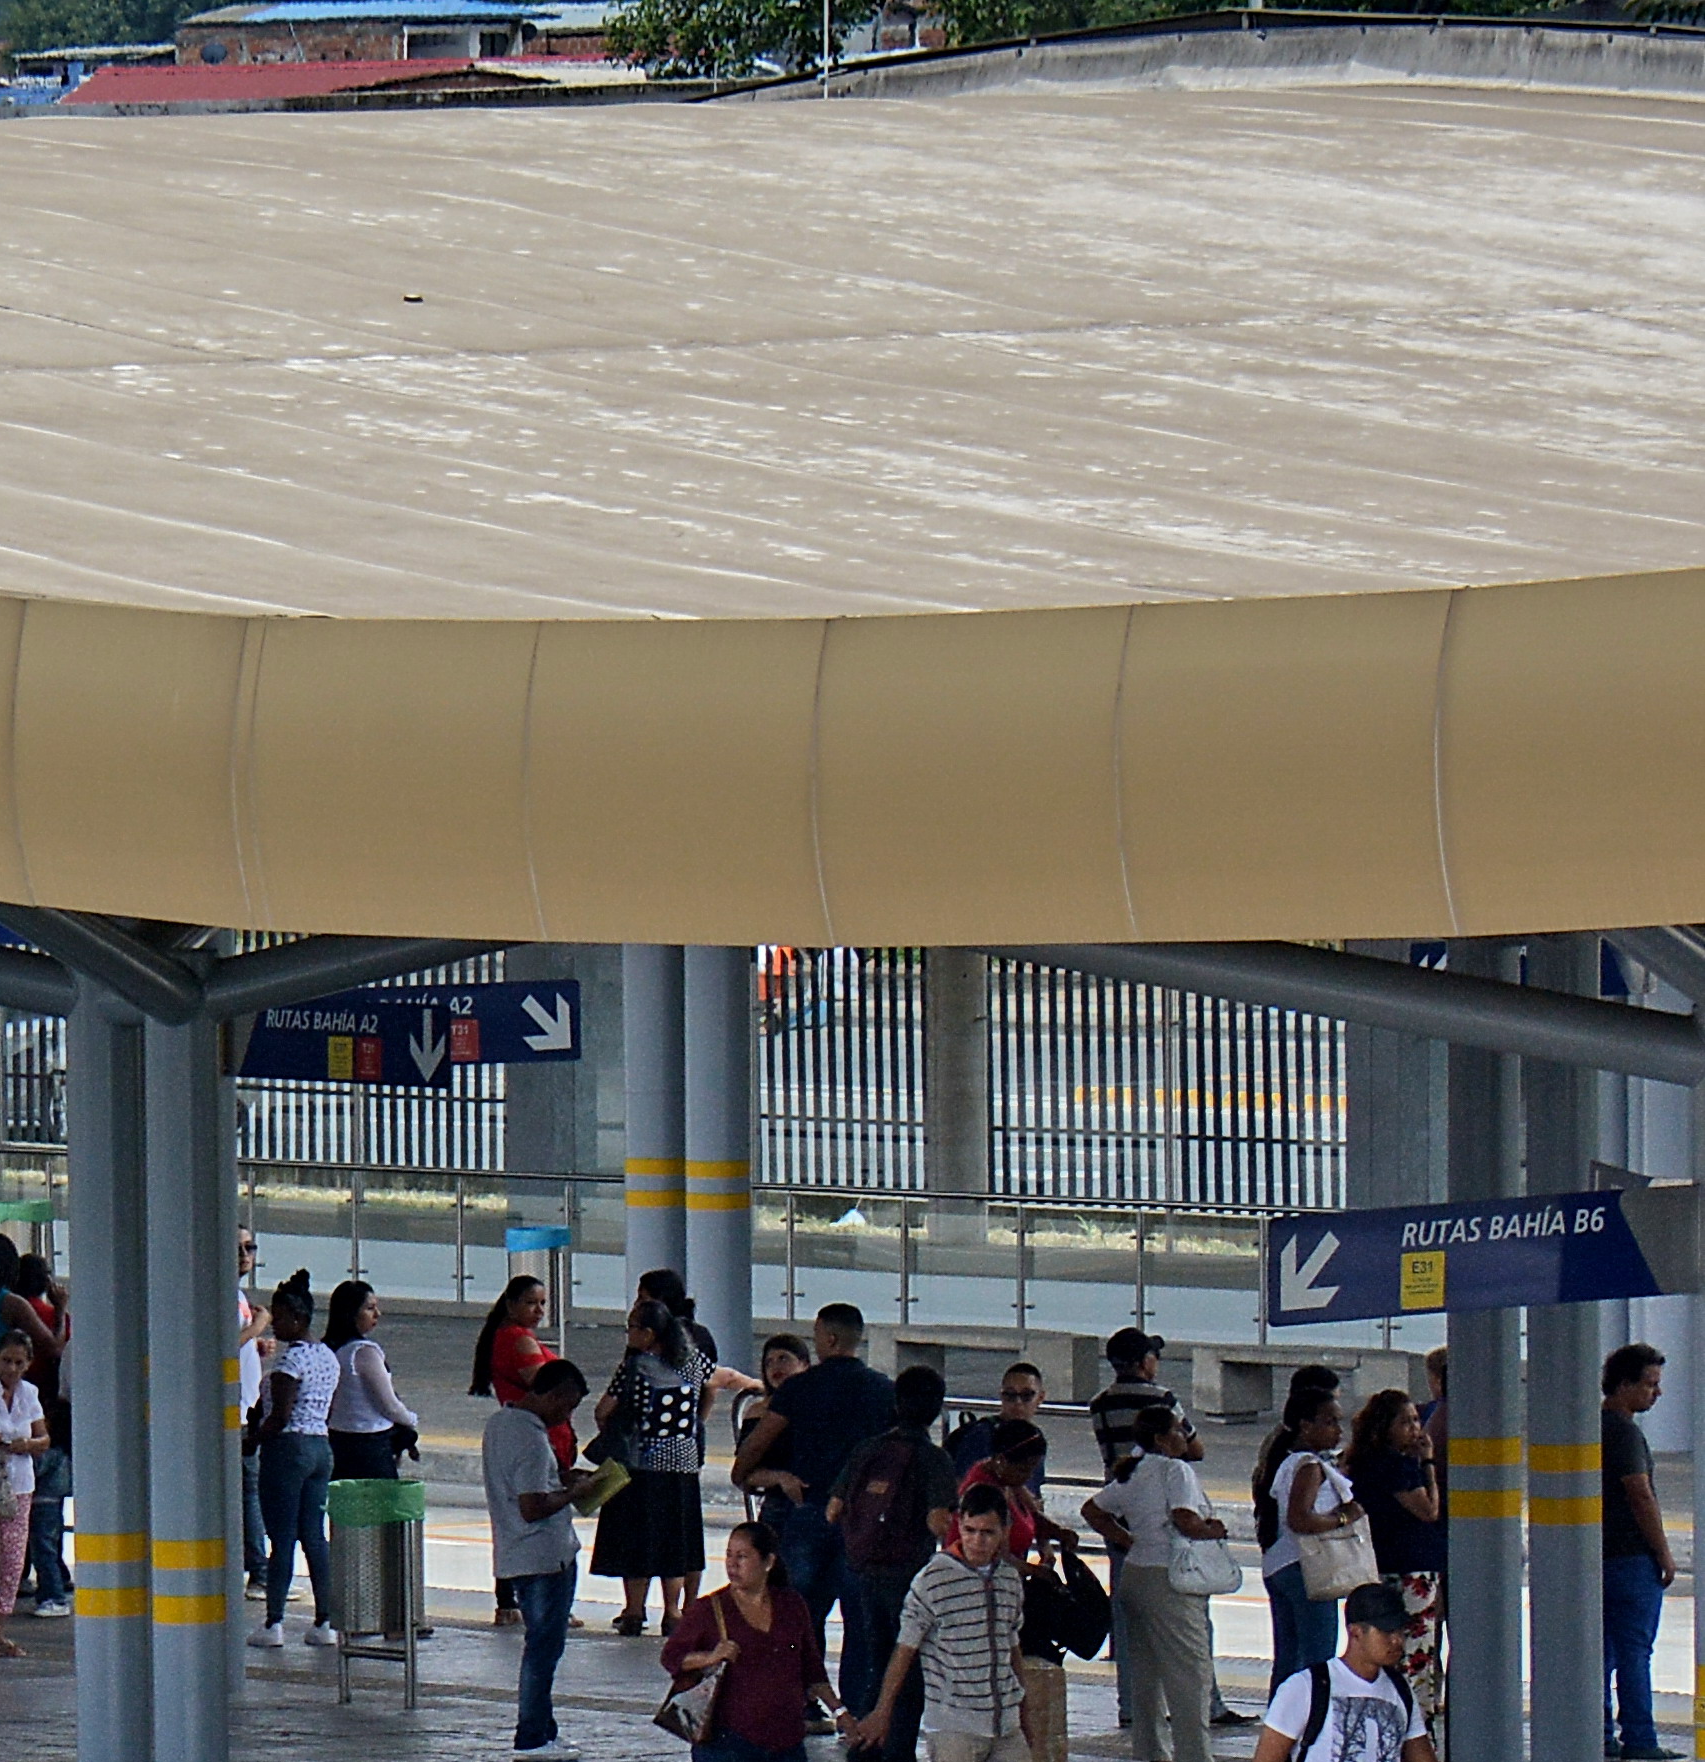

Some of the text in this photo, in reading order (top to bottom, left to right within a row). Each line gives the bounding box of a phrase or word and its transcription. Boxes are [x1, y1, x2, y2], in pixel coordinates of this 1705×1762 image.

[449, 996, 474, 1015] A2
[266, 1008, 379, 1034] RUTAS BAHÍA A2
[450, 1024, 470, 1036] T31
[1401, 1204, 1606, 1247] RUTAS BAHÍA B6
[1411, 1260, 1434, 1274] E31
